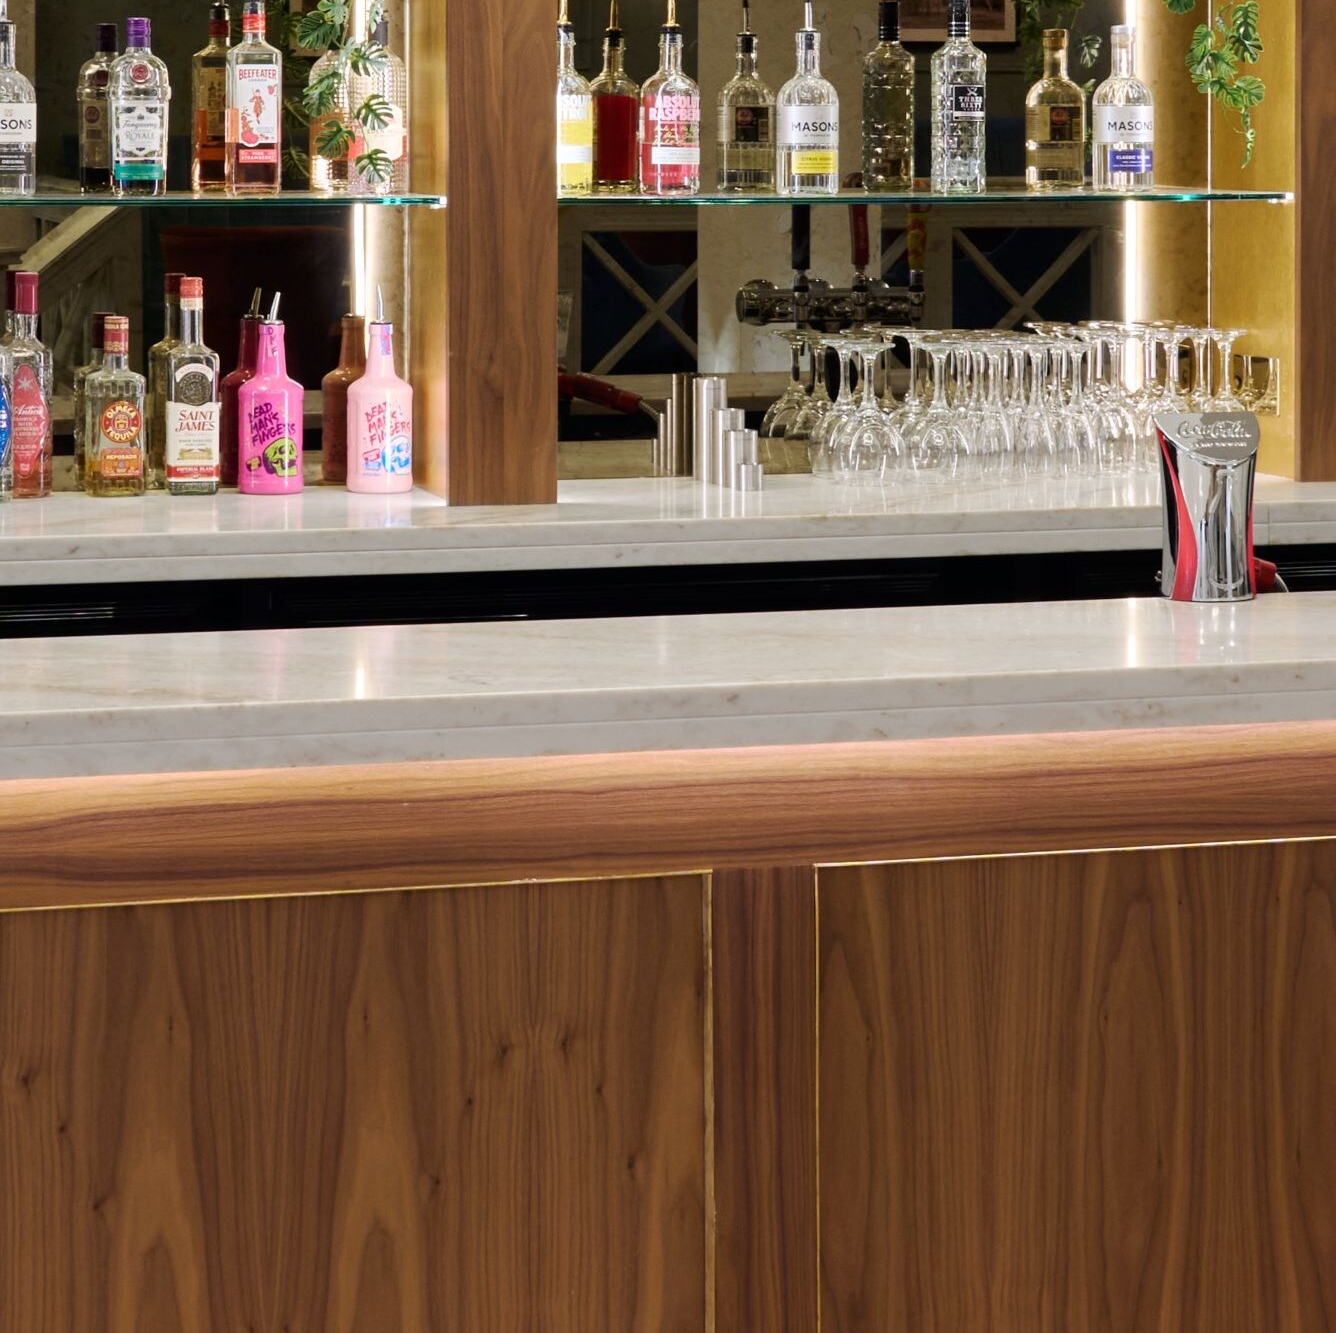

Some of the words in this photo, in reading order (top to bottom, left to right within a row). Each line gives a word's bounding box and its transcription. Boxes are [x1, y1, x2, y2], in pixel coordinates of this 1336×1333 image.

[238, 68, 276, 80] BEEFEATER
[791, 121, 838, 132] MASONS
[1107, 121, 1153, 131] MASONS
[106, 402, 137, 419] OLMECA
[178, 409, 214, 421] SAINT
[248, 402, 273, 423] DEAD
[175, 421, 216, 432] JAMES
[1176, 420, 1252, 439] Coca-Cola
[105, 425, 138, 442] TEQUILA
